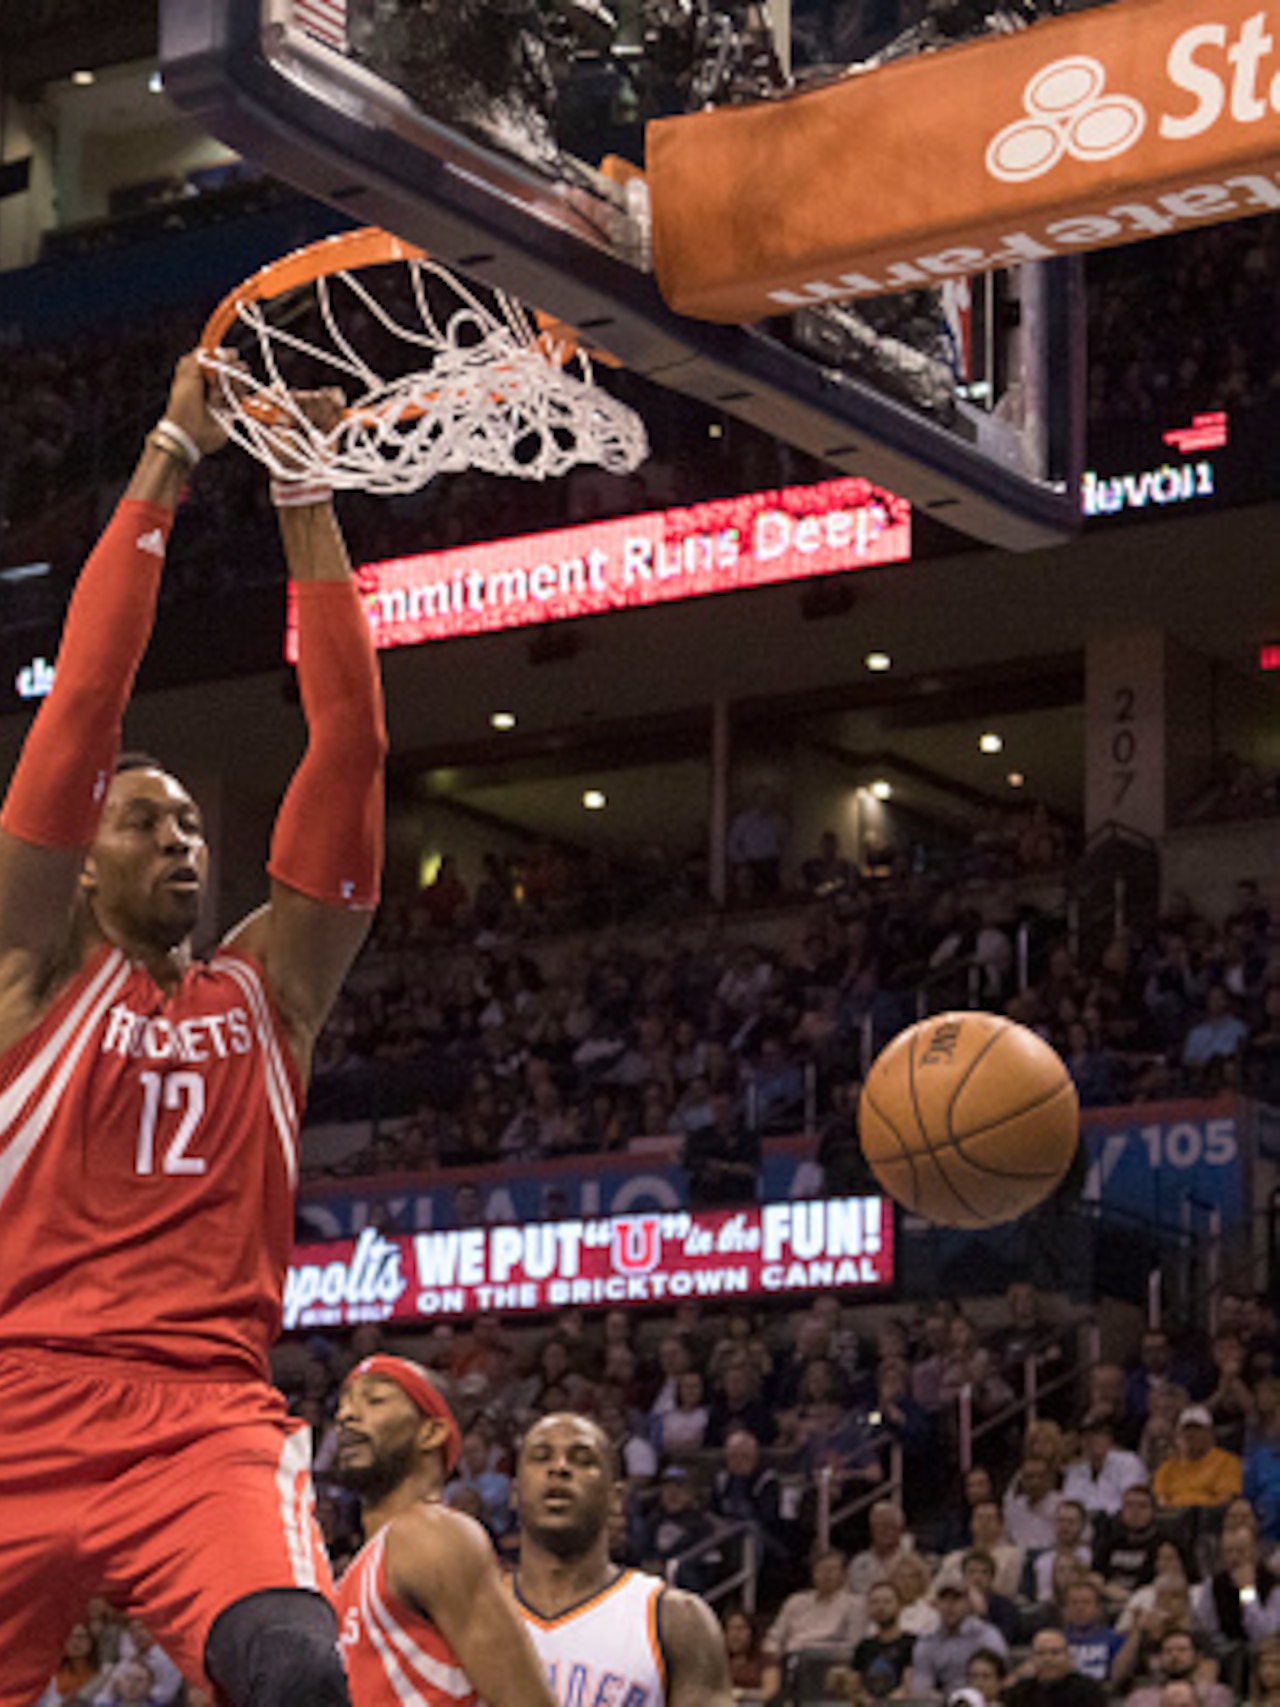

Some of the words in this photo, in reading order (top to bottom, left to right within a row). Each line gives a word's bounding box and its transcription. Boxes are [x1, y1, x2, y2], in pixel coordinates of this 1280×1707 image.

[1159, 11, 1280, 139] St
[1046, 173, 1280, 243] tate
[767, 232, 1056, 304] Farm
[368, 548, 608, 625] mmitment
[624, 528, 739, 584] Runs
[754, 504, 884, 561] Deep
[1112, 688, 1136, 803] 207
[103, 1000, 253, 1062] ROCETS
[135, 1070, 207, 1175] 12
[1141, 1119, 1237, 1169] 105
[415, 1229, 486, 1287] WE
[489, 1220, 583, 1282] PUT
[716, 1213, 761, 1253] the
[761, 1196, 882, 1262] FUN!
[417, 1287, 465, 1315] ON
[476, 1282, 538, 1313] THE
[548, 1265, 749, 1305] BRICKTOWN
[760, 1257, 879, 1290] CANAL
